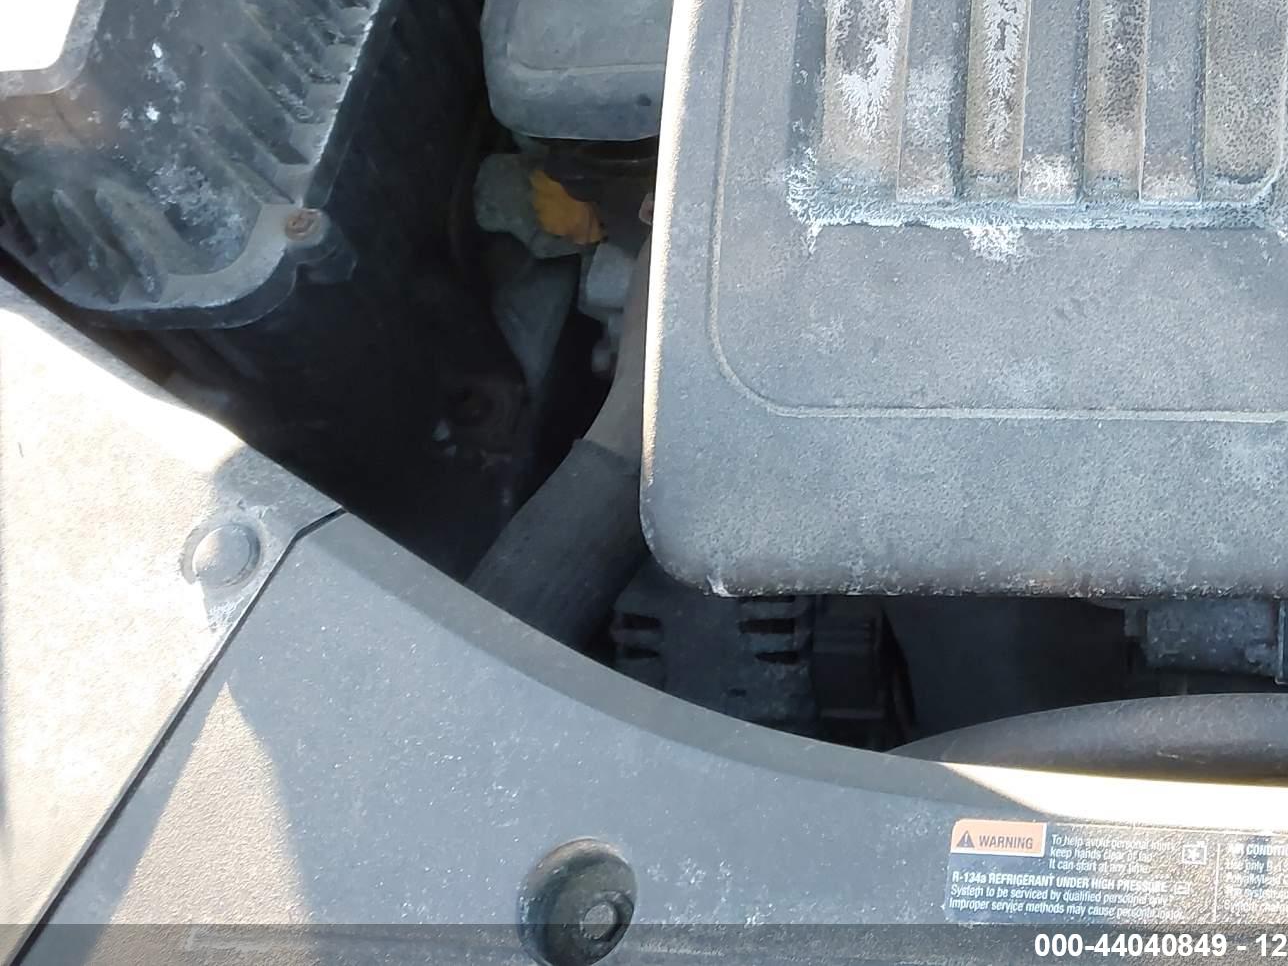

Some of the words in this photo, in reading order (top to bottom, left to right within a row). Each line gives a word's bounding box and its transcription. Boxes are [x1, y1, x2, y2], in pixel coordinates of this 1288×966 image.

[979, 835, 1034, 850] WARNING
[1050, 848, 1073, 861] keep
[1057, 862, 1073, 871] can
[952, 872, 986, 884] R-134a
[988, 873, 1054, 888] REFRIGERANT
[1056, 875, 1089, 888] UNDER
[1091, 877, 1115, 890] HIGH
[1116, 878, 1168, 893] PRESSURE
[951, 884, 983, 898] System
[986, 887, 994, 897] to
[996, 886, 1009, 898] be
[1010, 888, 1048, 901] serviced
[1050, 889, 1062, 902] by
[1063, 890, 1101, 903] qualified
[949, 898, 989, 911] Improper
[991, 900, 1023, 913] service
[1025, 901, 1064, 914] methods
[1066, 904, 1086, 917] may
[1087, 905, 1115, 916] cause
